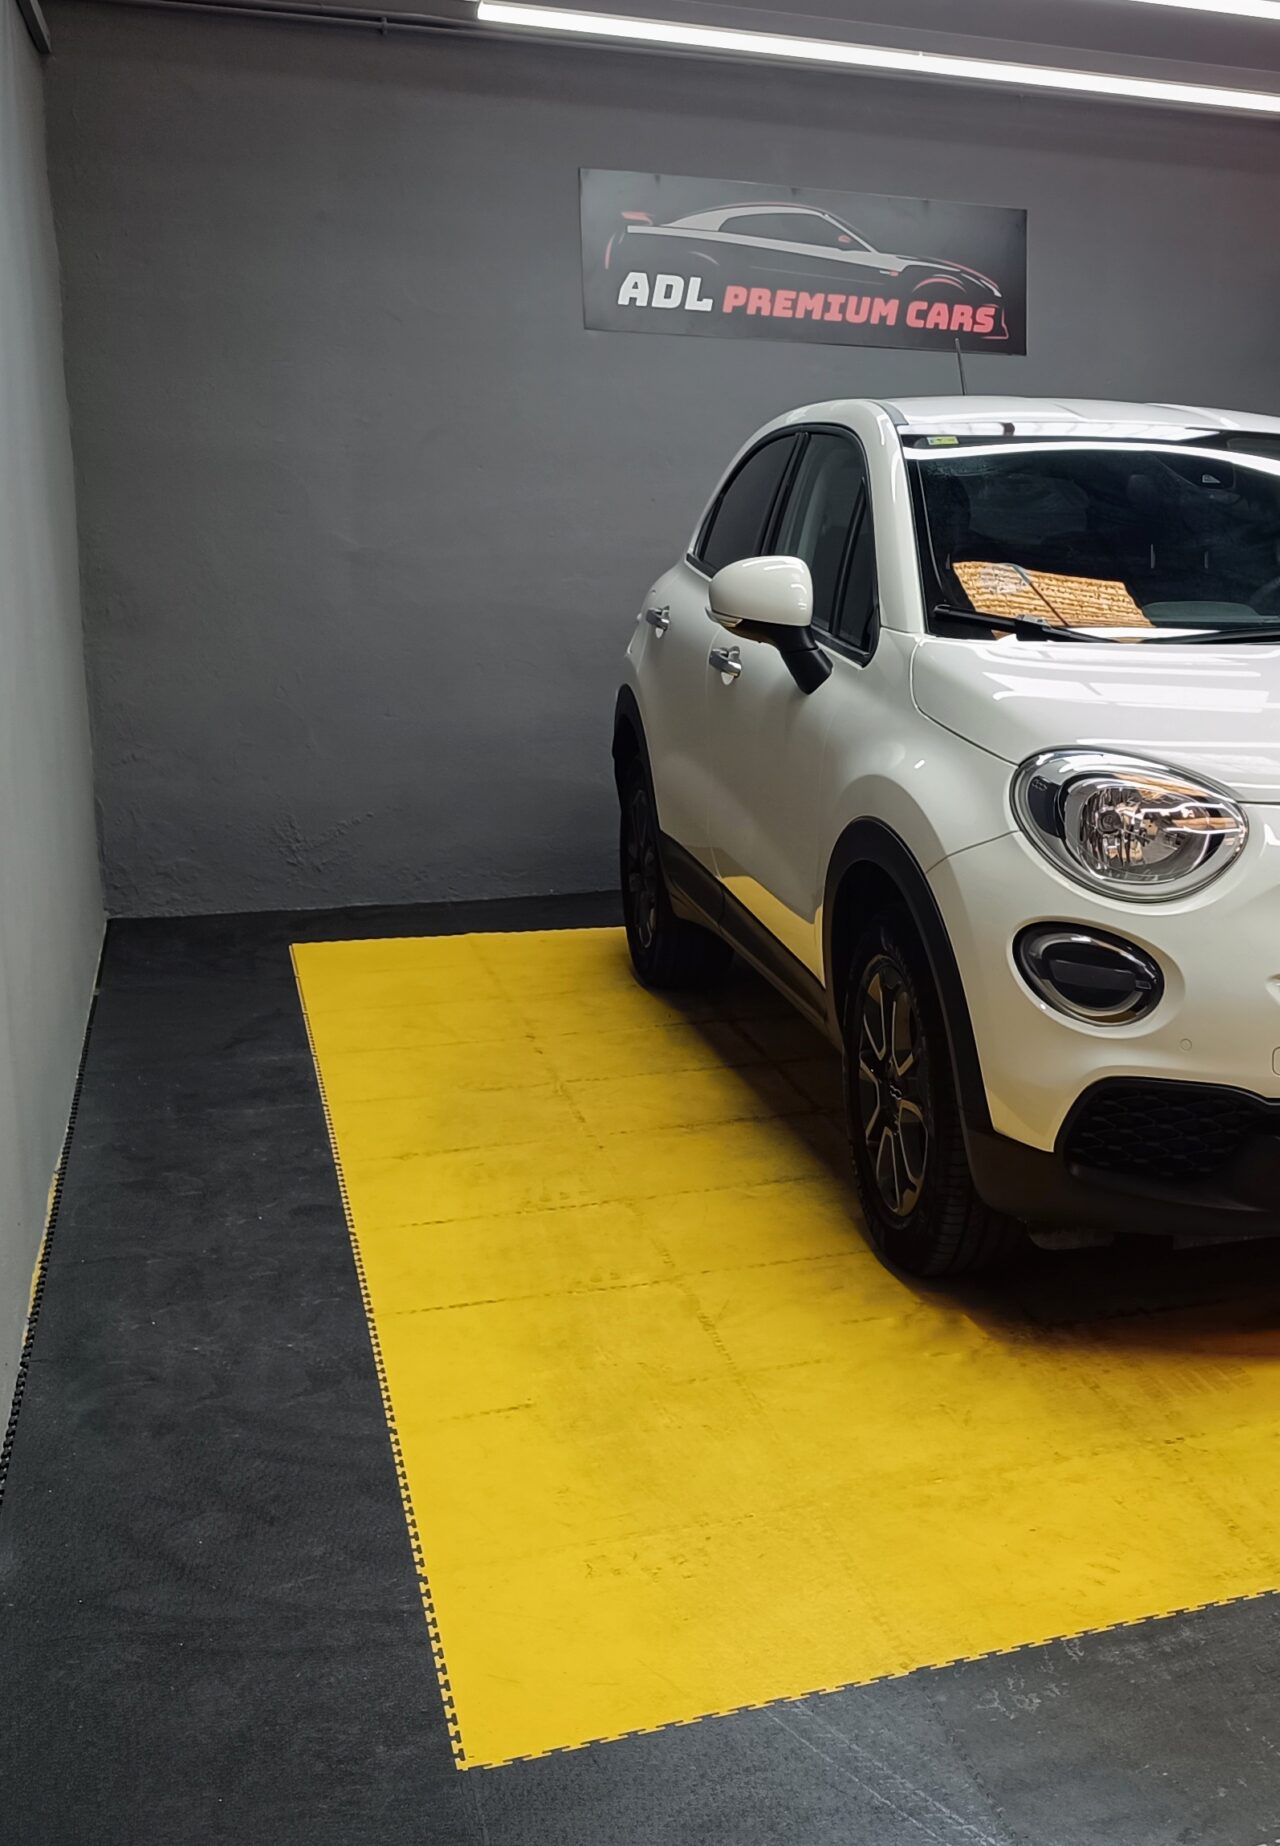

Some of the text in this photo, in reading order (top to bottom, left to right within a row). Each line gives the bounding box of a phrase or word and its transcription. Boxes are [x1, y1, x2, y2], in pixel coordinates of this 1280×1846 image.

[617, 271, 996, 333] ADL PREMIUM CARS
